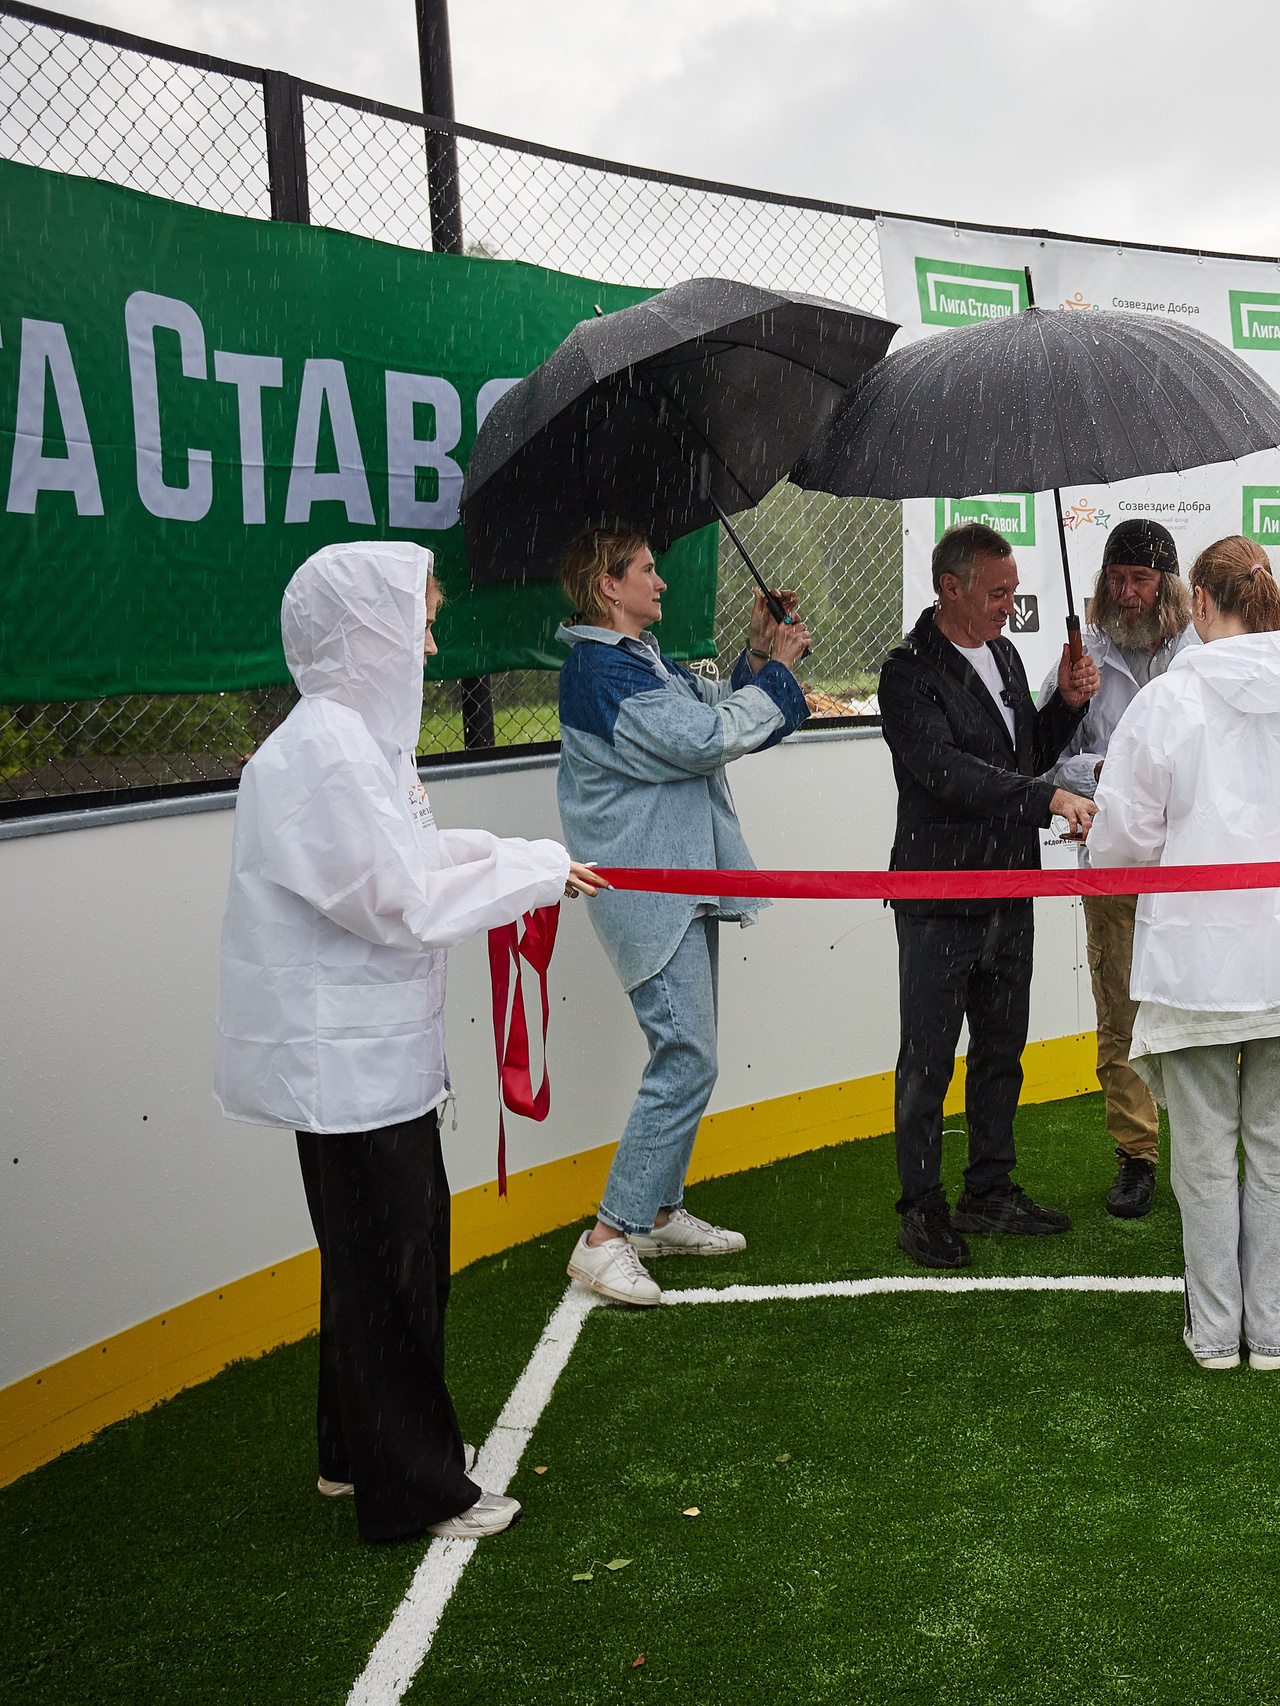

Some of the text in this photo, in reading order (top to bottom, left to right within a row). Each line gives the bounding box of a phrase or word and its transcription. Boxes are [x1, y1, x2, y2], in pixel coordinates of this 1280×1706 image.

[1112, 297, 1200, 315] Созвездие Добра
[1118, 501, 1211, 513] Созвездие Добра
